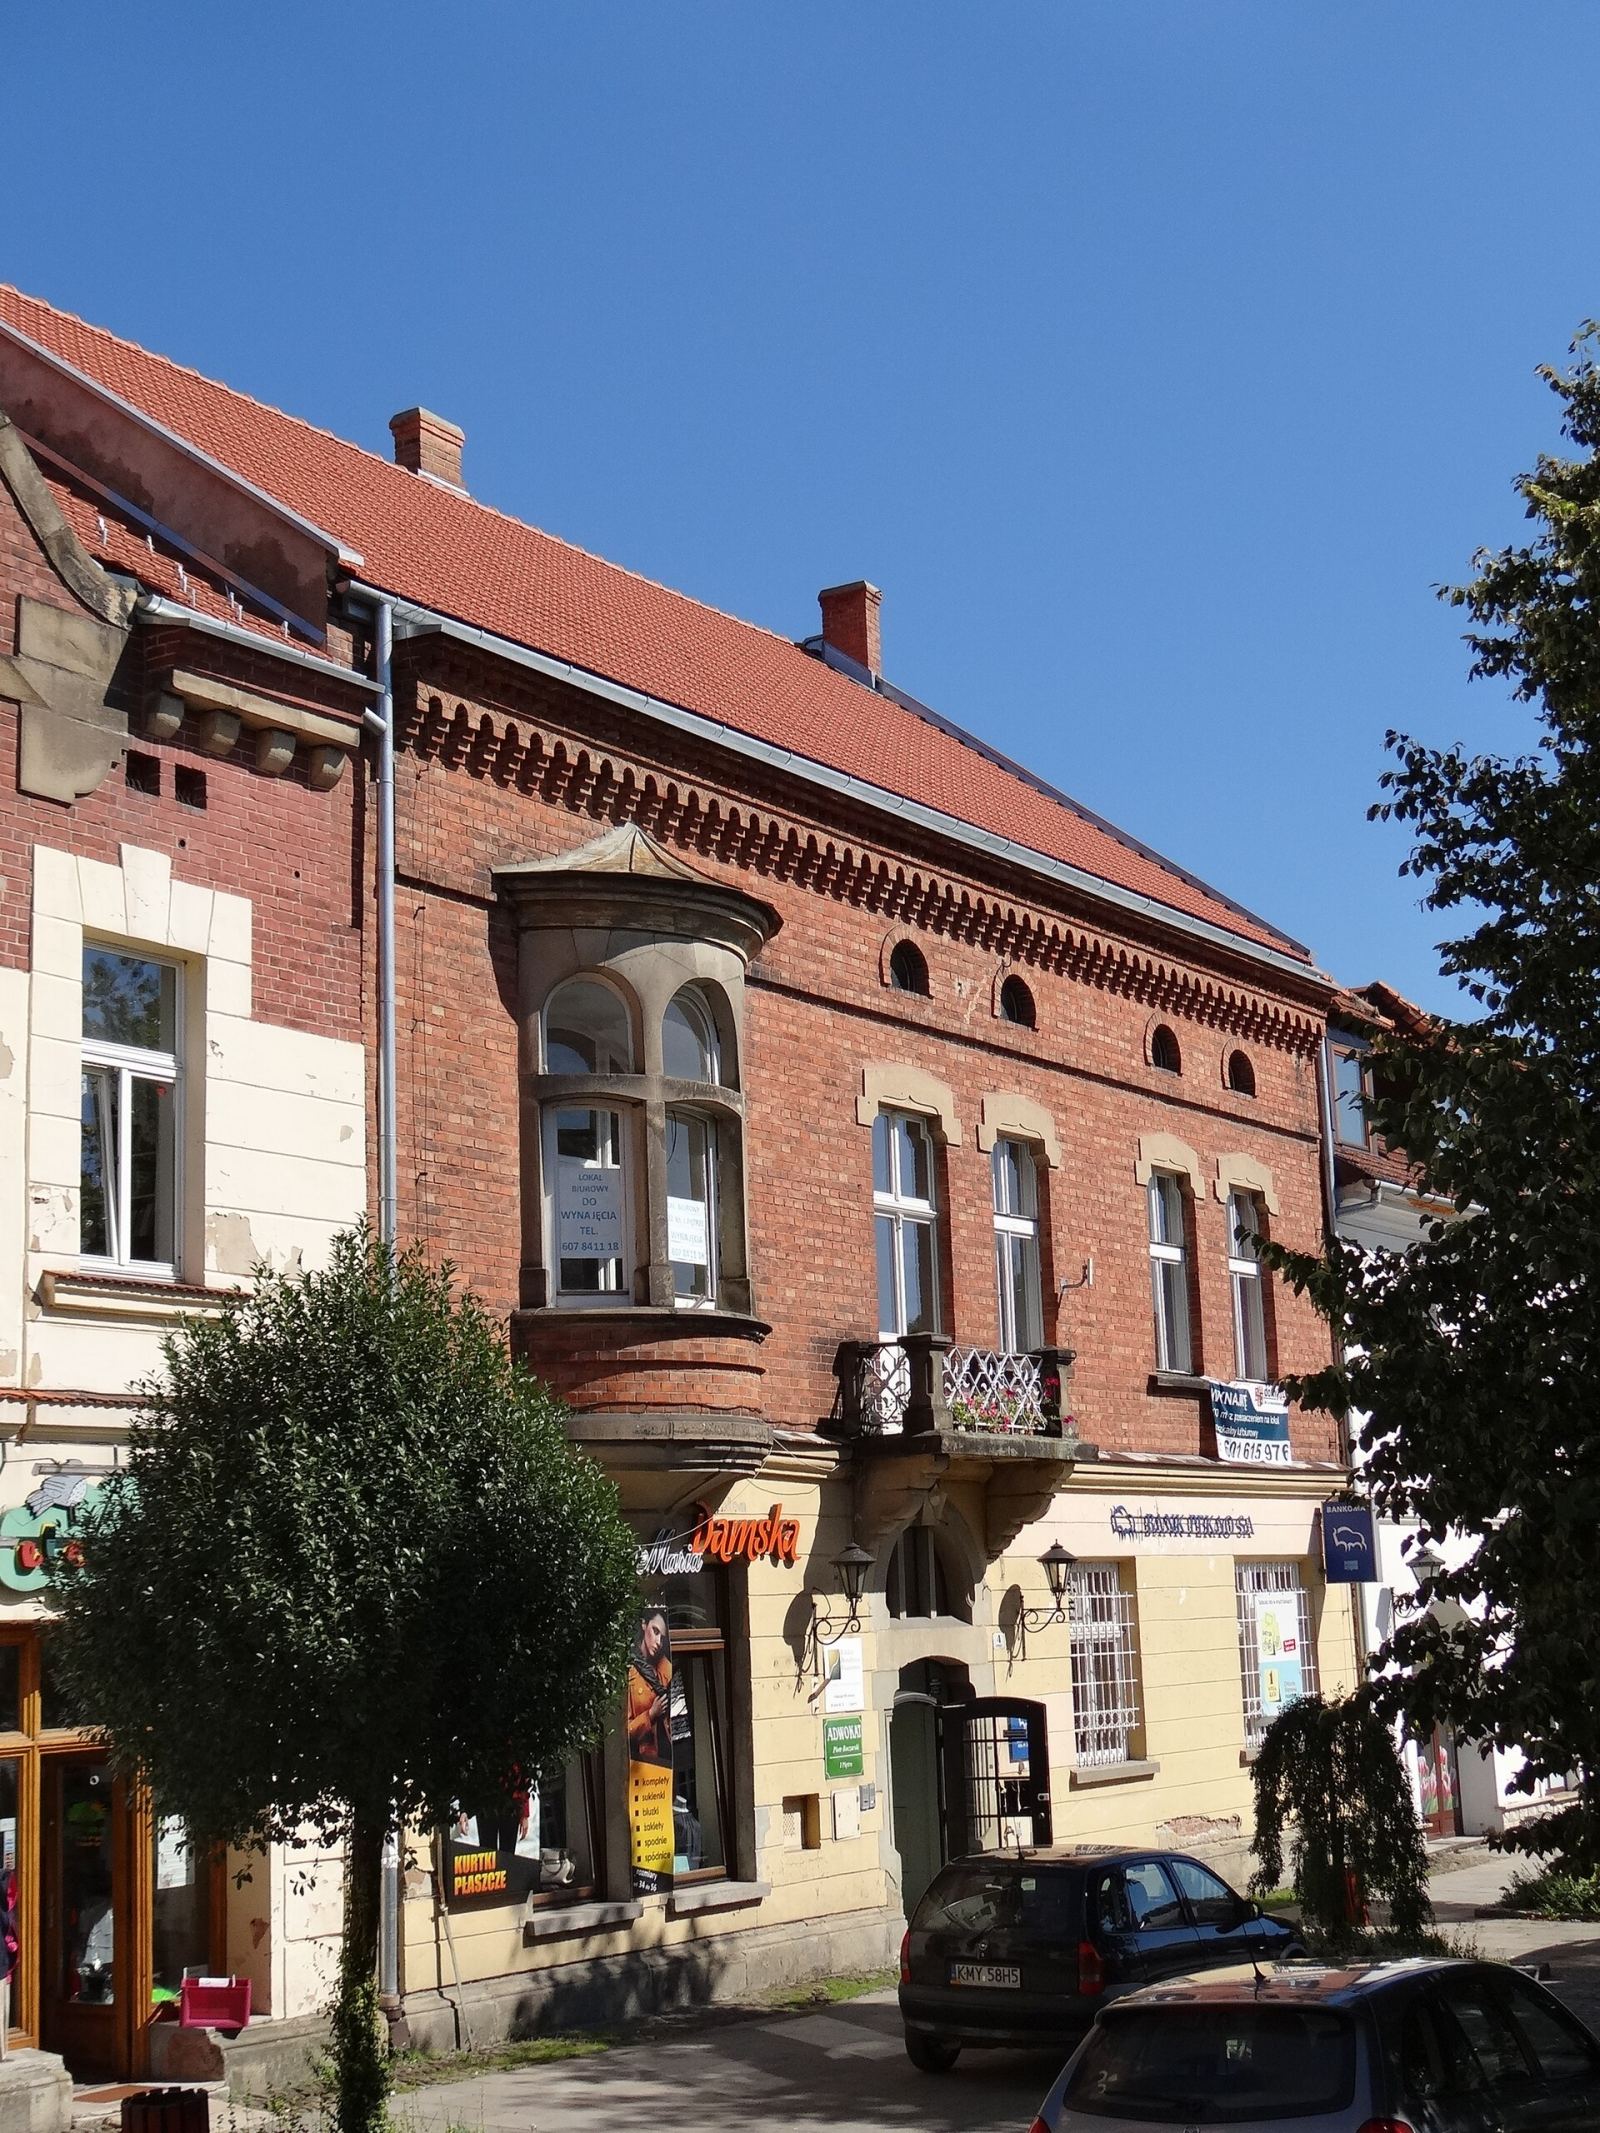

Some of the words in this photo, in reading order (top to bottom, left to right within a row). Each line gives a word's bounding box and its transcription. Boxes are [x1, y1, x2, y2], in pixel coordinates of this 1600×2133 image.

[571, 1185, 609, 1193] BIUROWY
[582, 1197, 597, 1206] DO
[561, 1211, 617, 1221] WYNAJĘCIA
[580, 1226, 599, 1235] TEL.
[562, 1242, 579, 1251] 607
[1243, 1442, 1262, 1460] 615
[1144, 1513, 1184, 1535] BANK
[691, 1500, 801, 1563] Damska
[642, 1777, 670, 1787] komplety
[642, 1791, 665, 1801] sukienki
[642, 1807, 659, 1816] bluzki
[644, 1837, 667, 1848] spodnie
[645, 1852, 671, 1863] spódnice
[454, 1851, 497, 1875] KURTKI
[454, 1870, 507, 1896] PŁASZCZE
[957, 1965, 982, 1981] KMY
